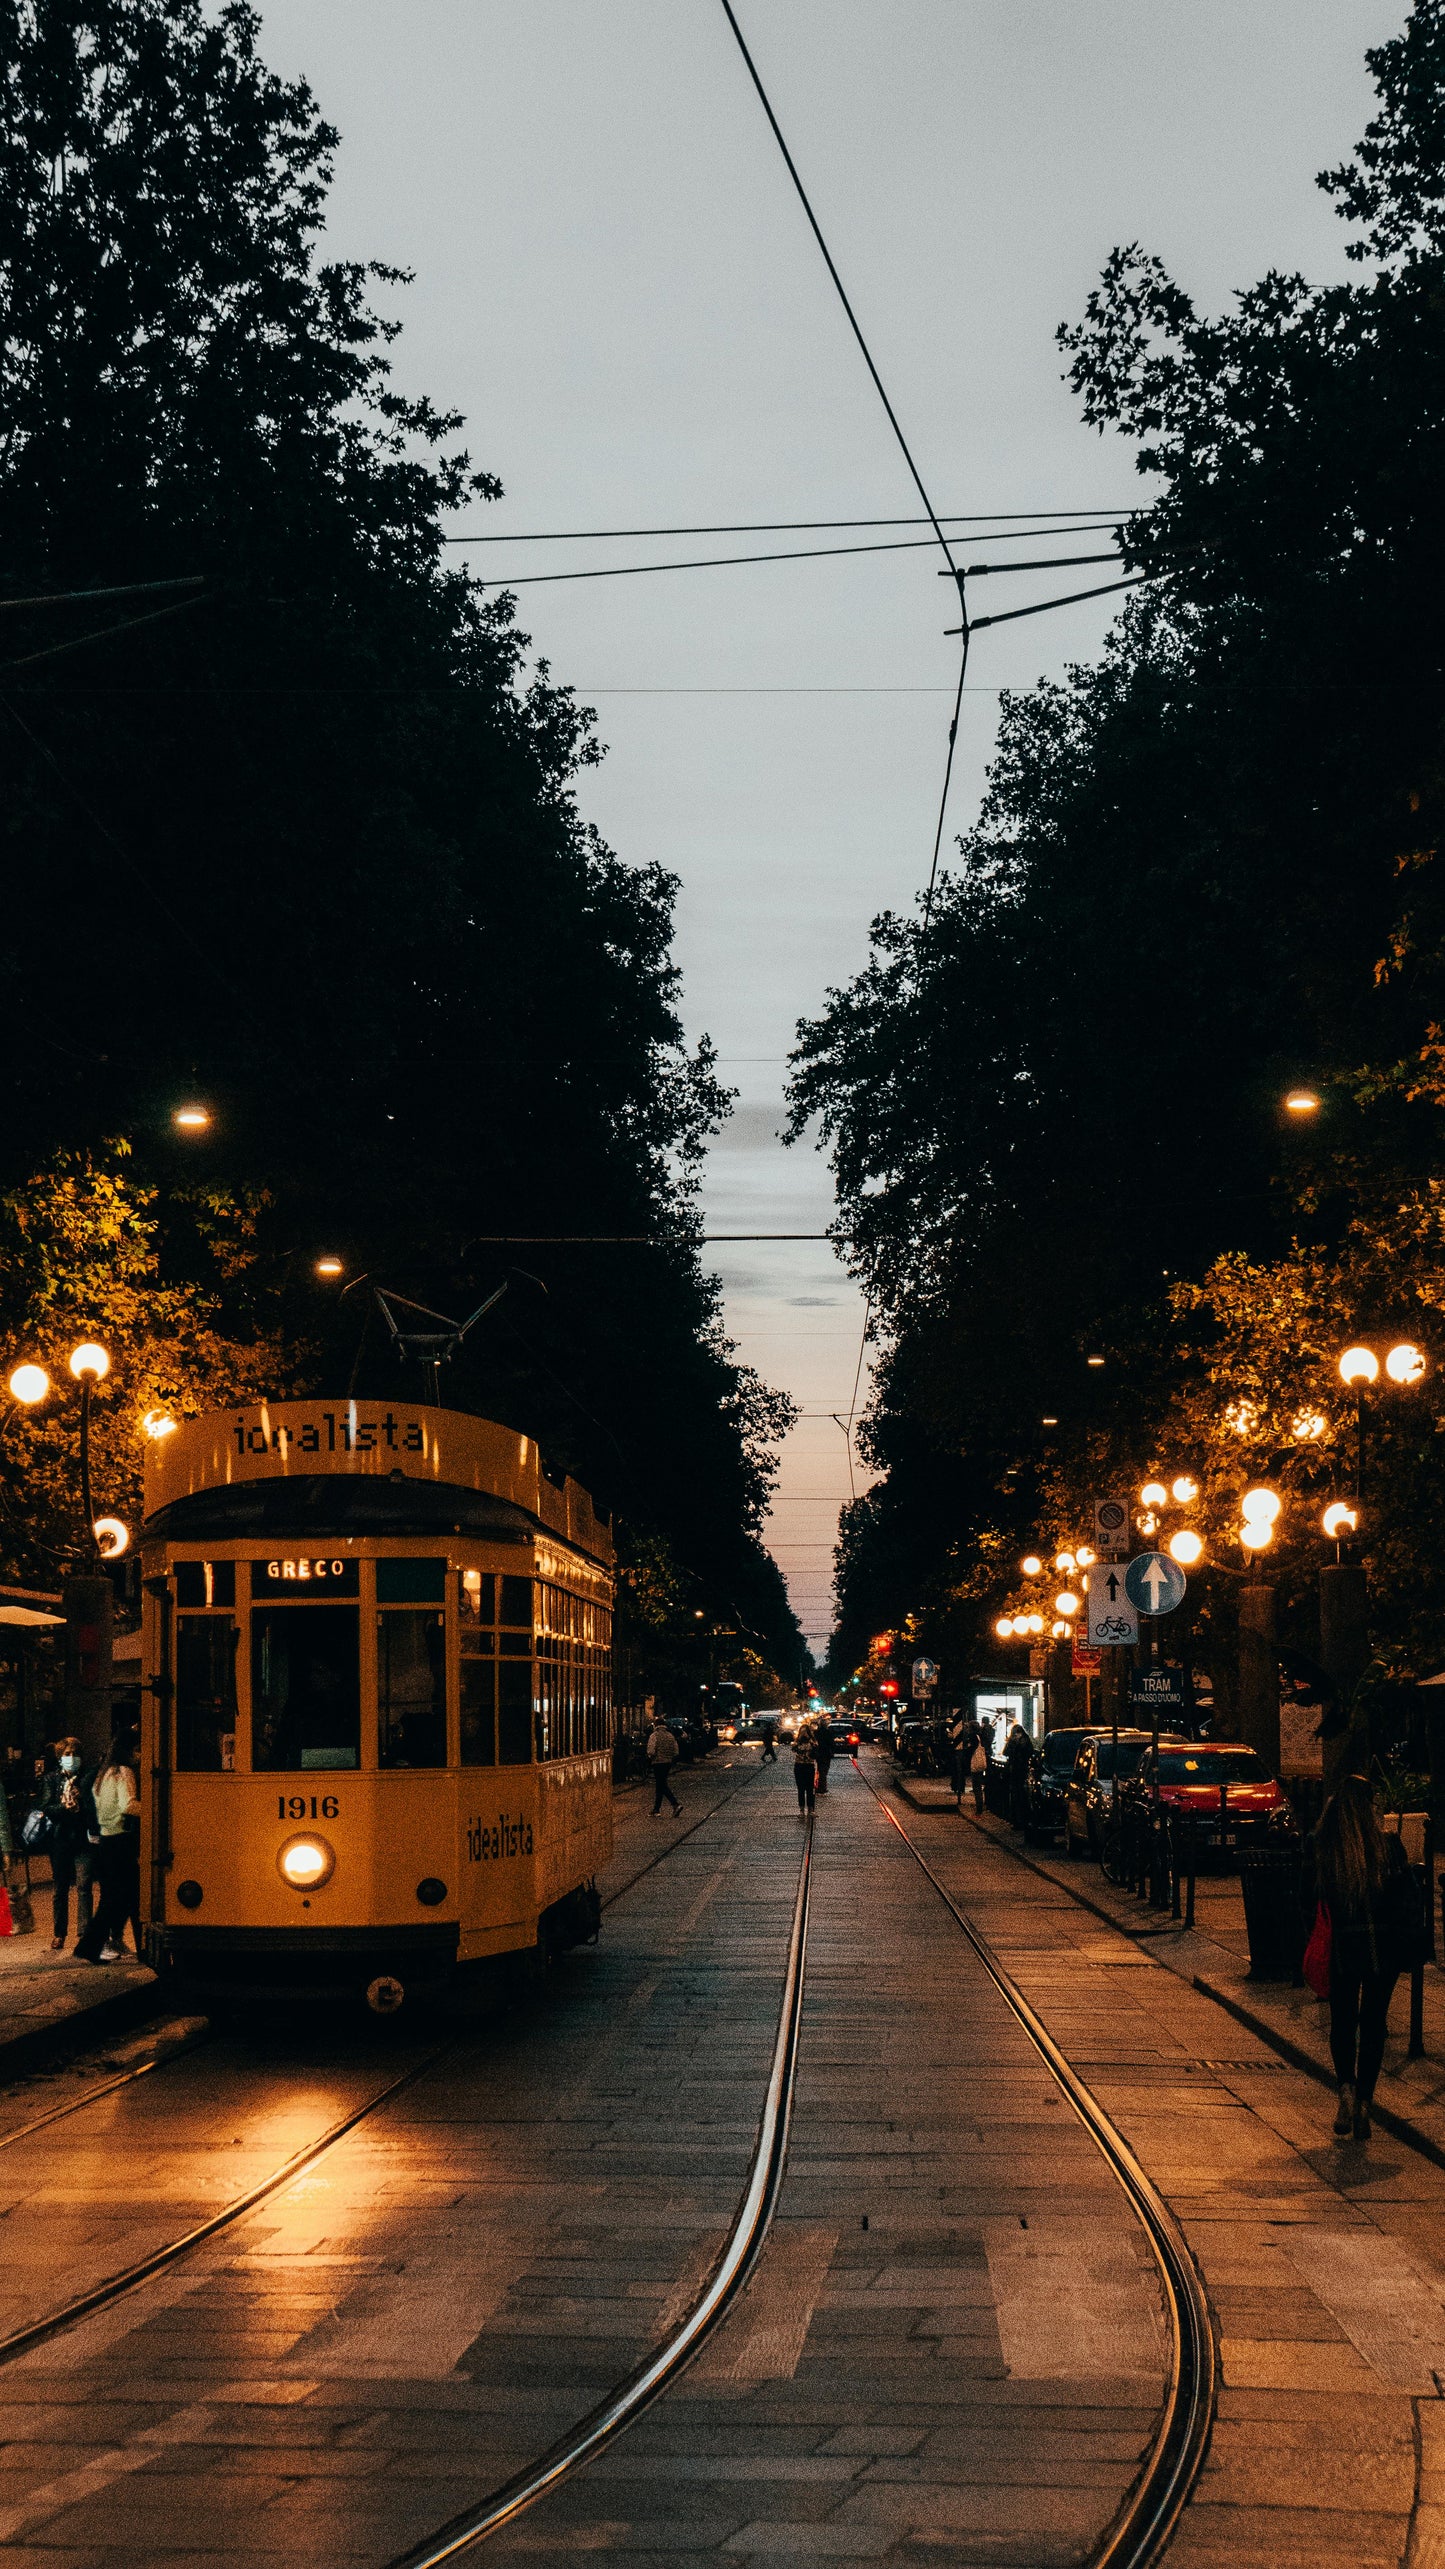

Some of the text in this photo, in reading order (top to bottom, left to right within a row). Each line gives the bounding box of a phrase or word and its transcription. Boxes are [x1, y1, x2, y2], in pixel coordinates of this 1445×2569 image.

[234, 1412, 423, 1454] idealista
[267, 1559, 344, 1579] GRECO
[1142, 1678, 1171, 1692] TRAM
[1132, 1693, 1181, 1702] A PASSO D'UOMO
[277, 1796, 340, 1820] 1916
[467, 1813, 534, 1863] idealista
